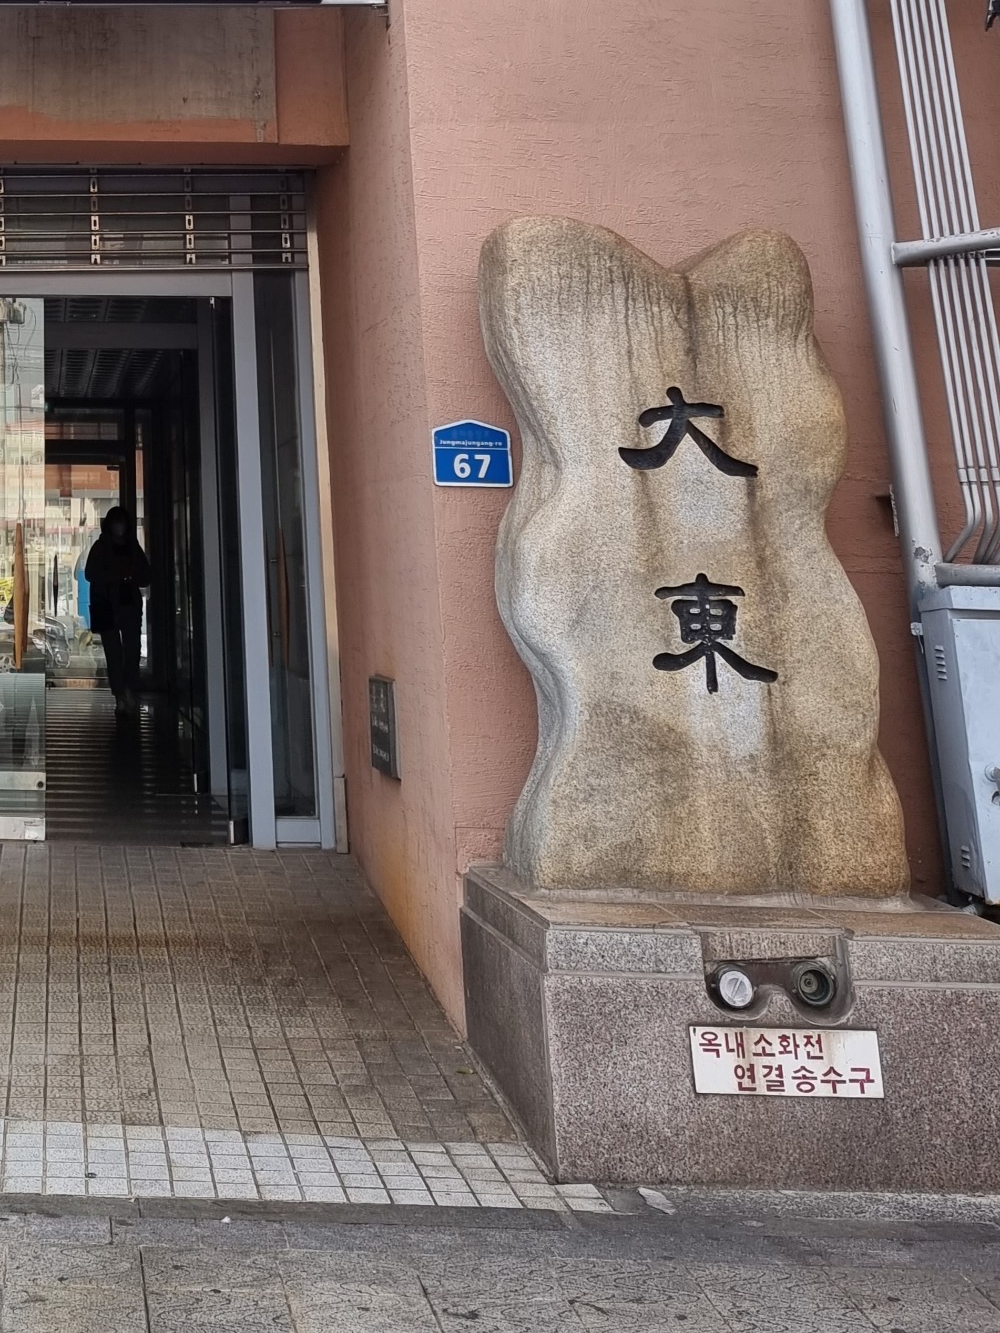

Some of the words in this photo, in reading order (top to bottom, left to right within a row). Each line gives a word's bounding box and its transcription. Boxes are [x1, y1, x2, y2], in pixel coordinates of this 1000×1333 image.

[453, 453, 491, 479] 67
[618, 386, 779, 696] 大東
[699, 1031, 747, 1059] 옥내
[752, 1032, 825, 1060] 소화전
